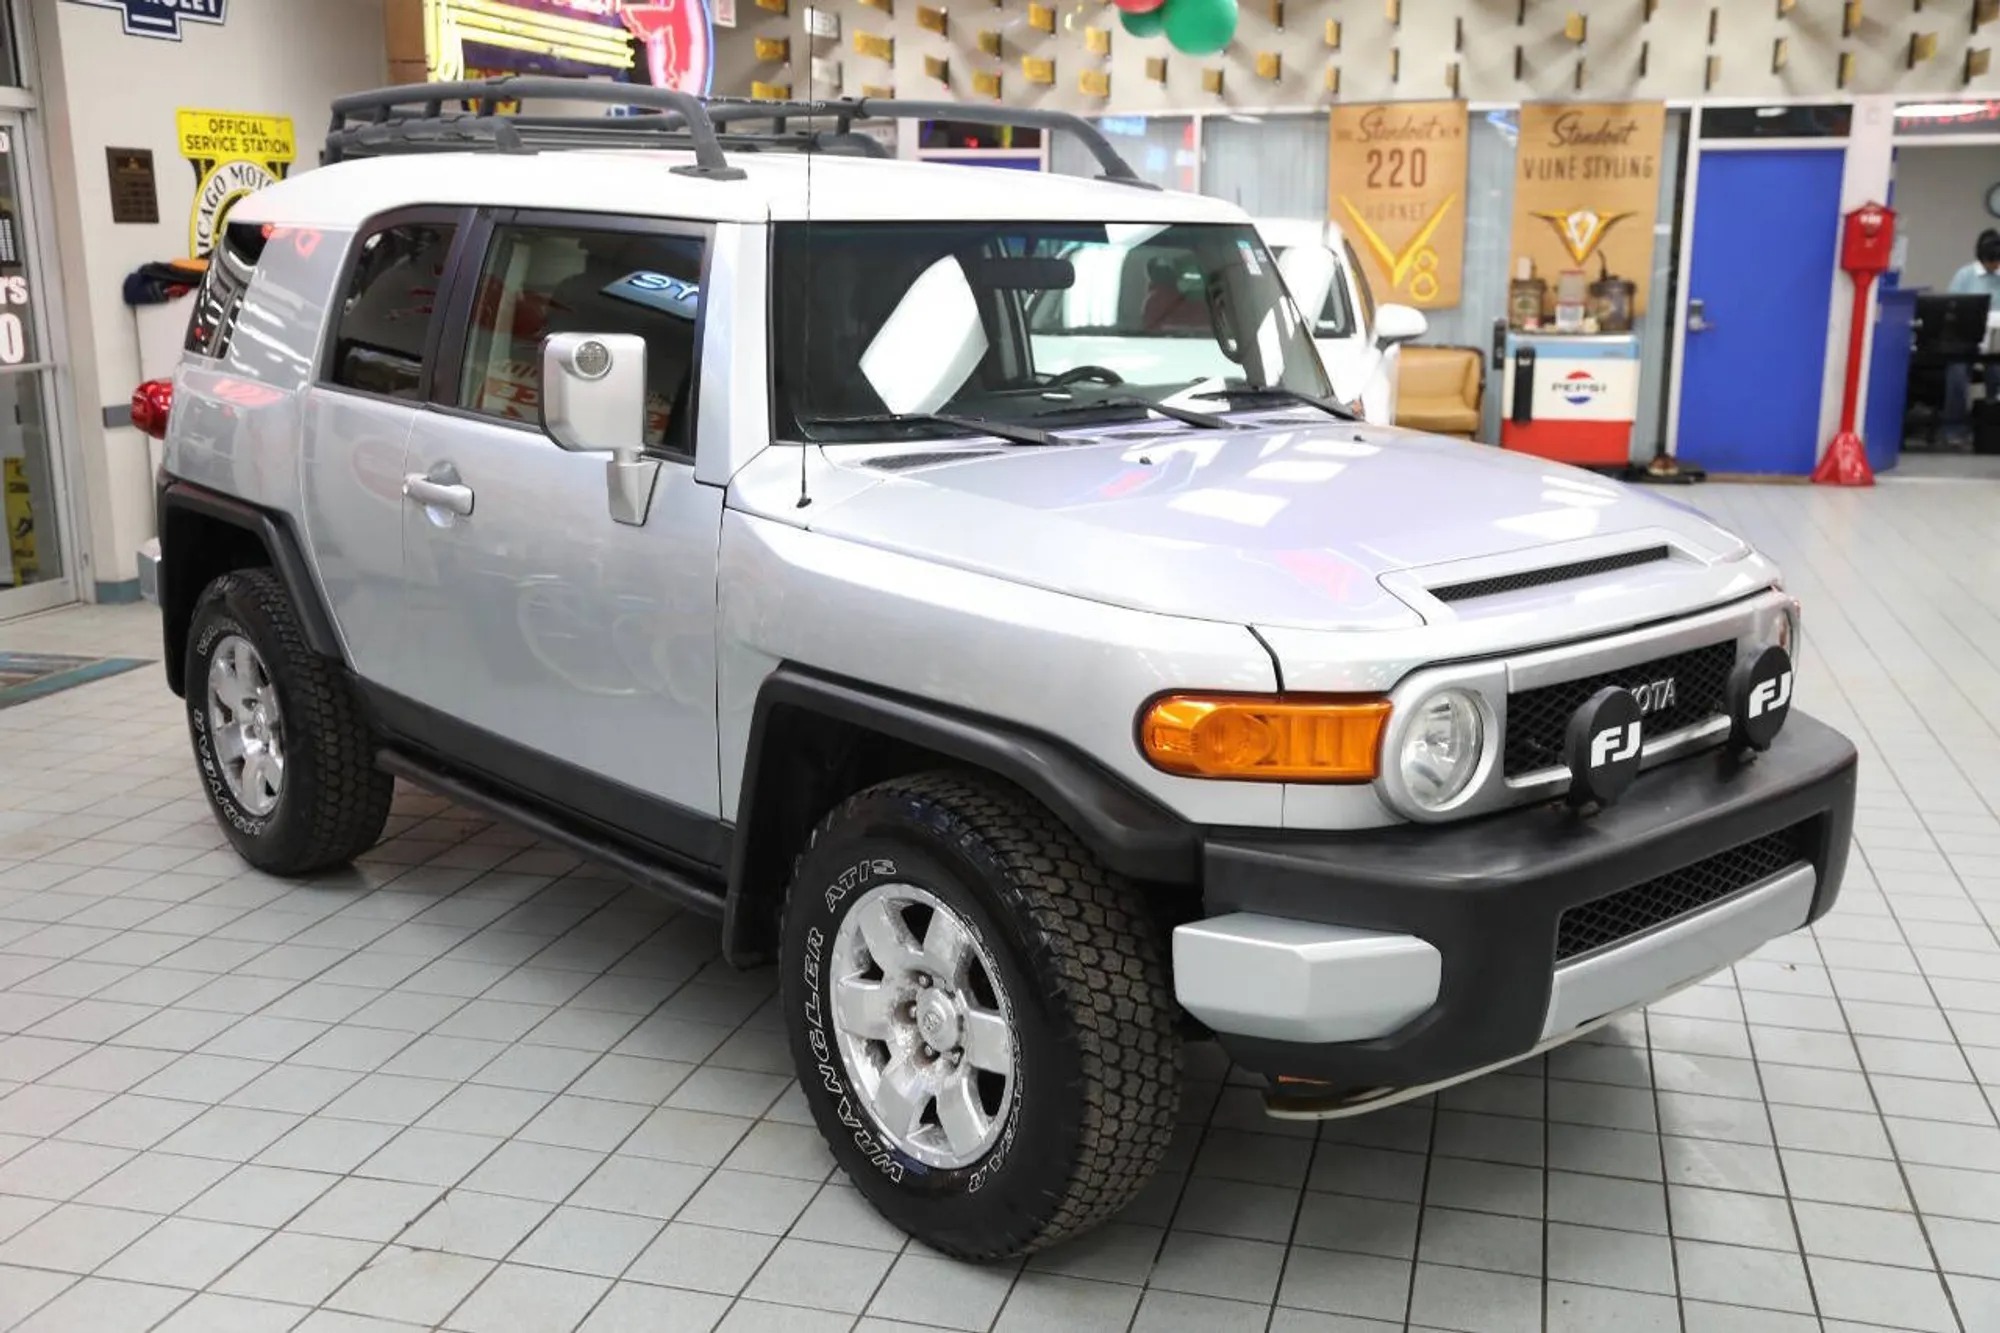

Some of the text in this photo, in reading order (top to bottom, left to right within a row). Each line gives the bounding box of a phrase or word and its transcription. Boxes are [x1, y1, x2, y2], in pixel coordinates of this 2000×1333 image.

[185, 134, 290, 154] SERVICE STATION
[208, 118, 266, 136] OFFICIAL
[1366, 147, 1427, 189] 220
[1552, 382, 1607, 393] PEPSI
[1749, 671, 1791, 719] FJ
[1591, 720, 1641, 768] FJ
[803, 926, 904, 1182] WRANGLER
